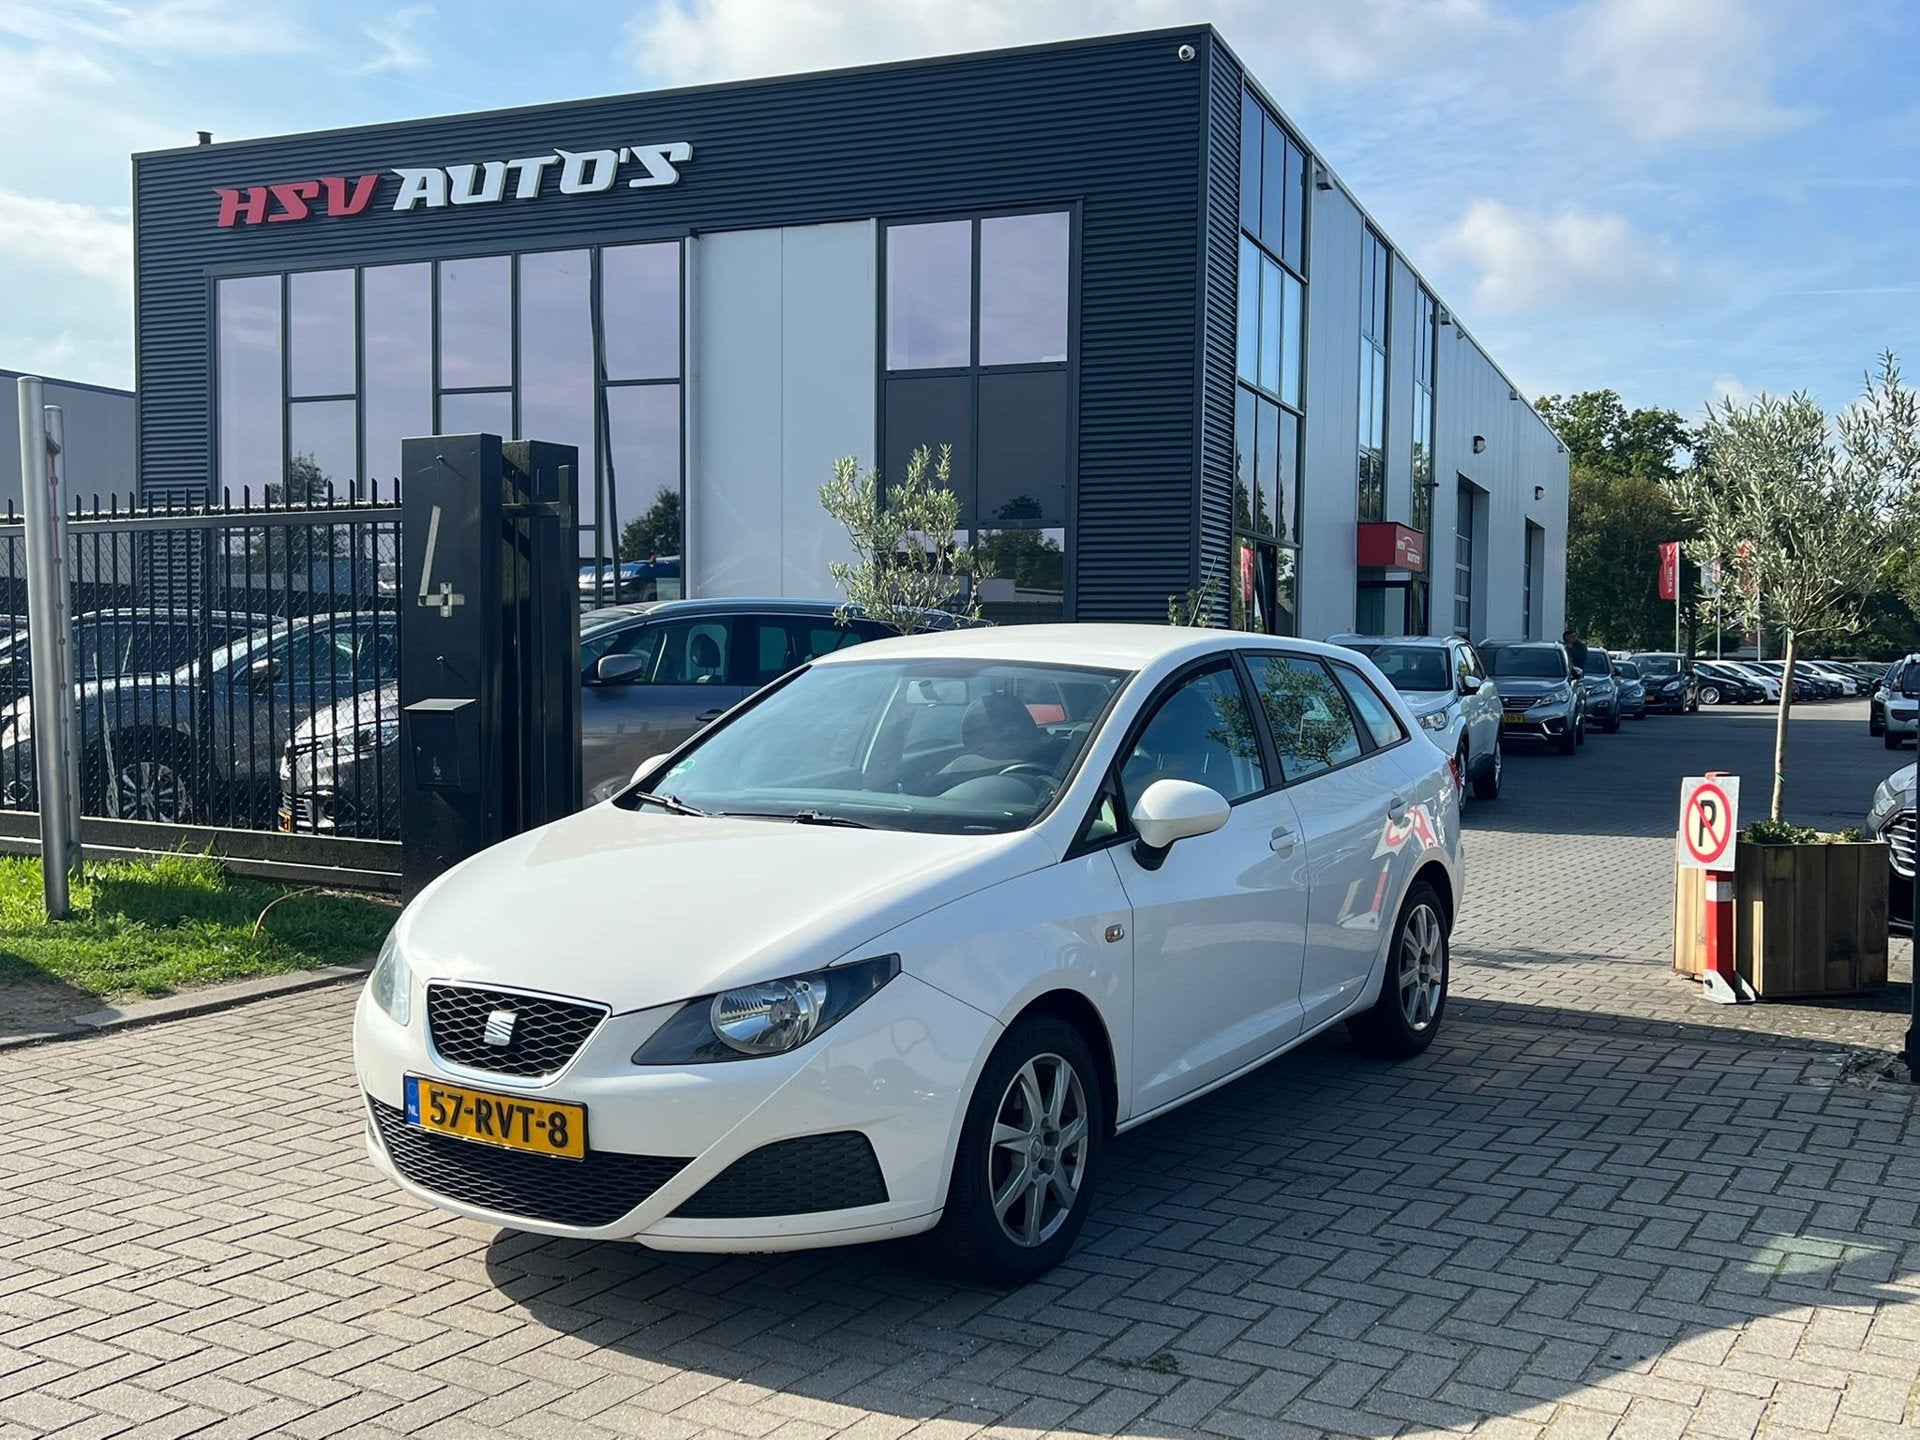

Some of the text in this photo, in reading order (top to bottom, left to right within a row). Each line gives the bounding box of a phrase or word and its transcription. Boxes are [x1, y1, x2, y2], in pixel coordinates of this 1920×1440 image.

[213, 141, 694, 228] HSV AUTO'S
[407, 1104, 419, 1117] NL
[430, 1088, 569, 1149] 57-RVT-8
